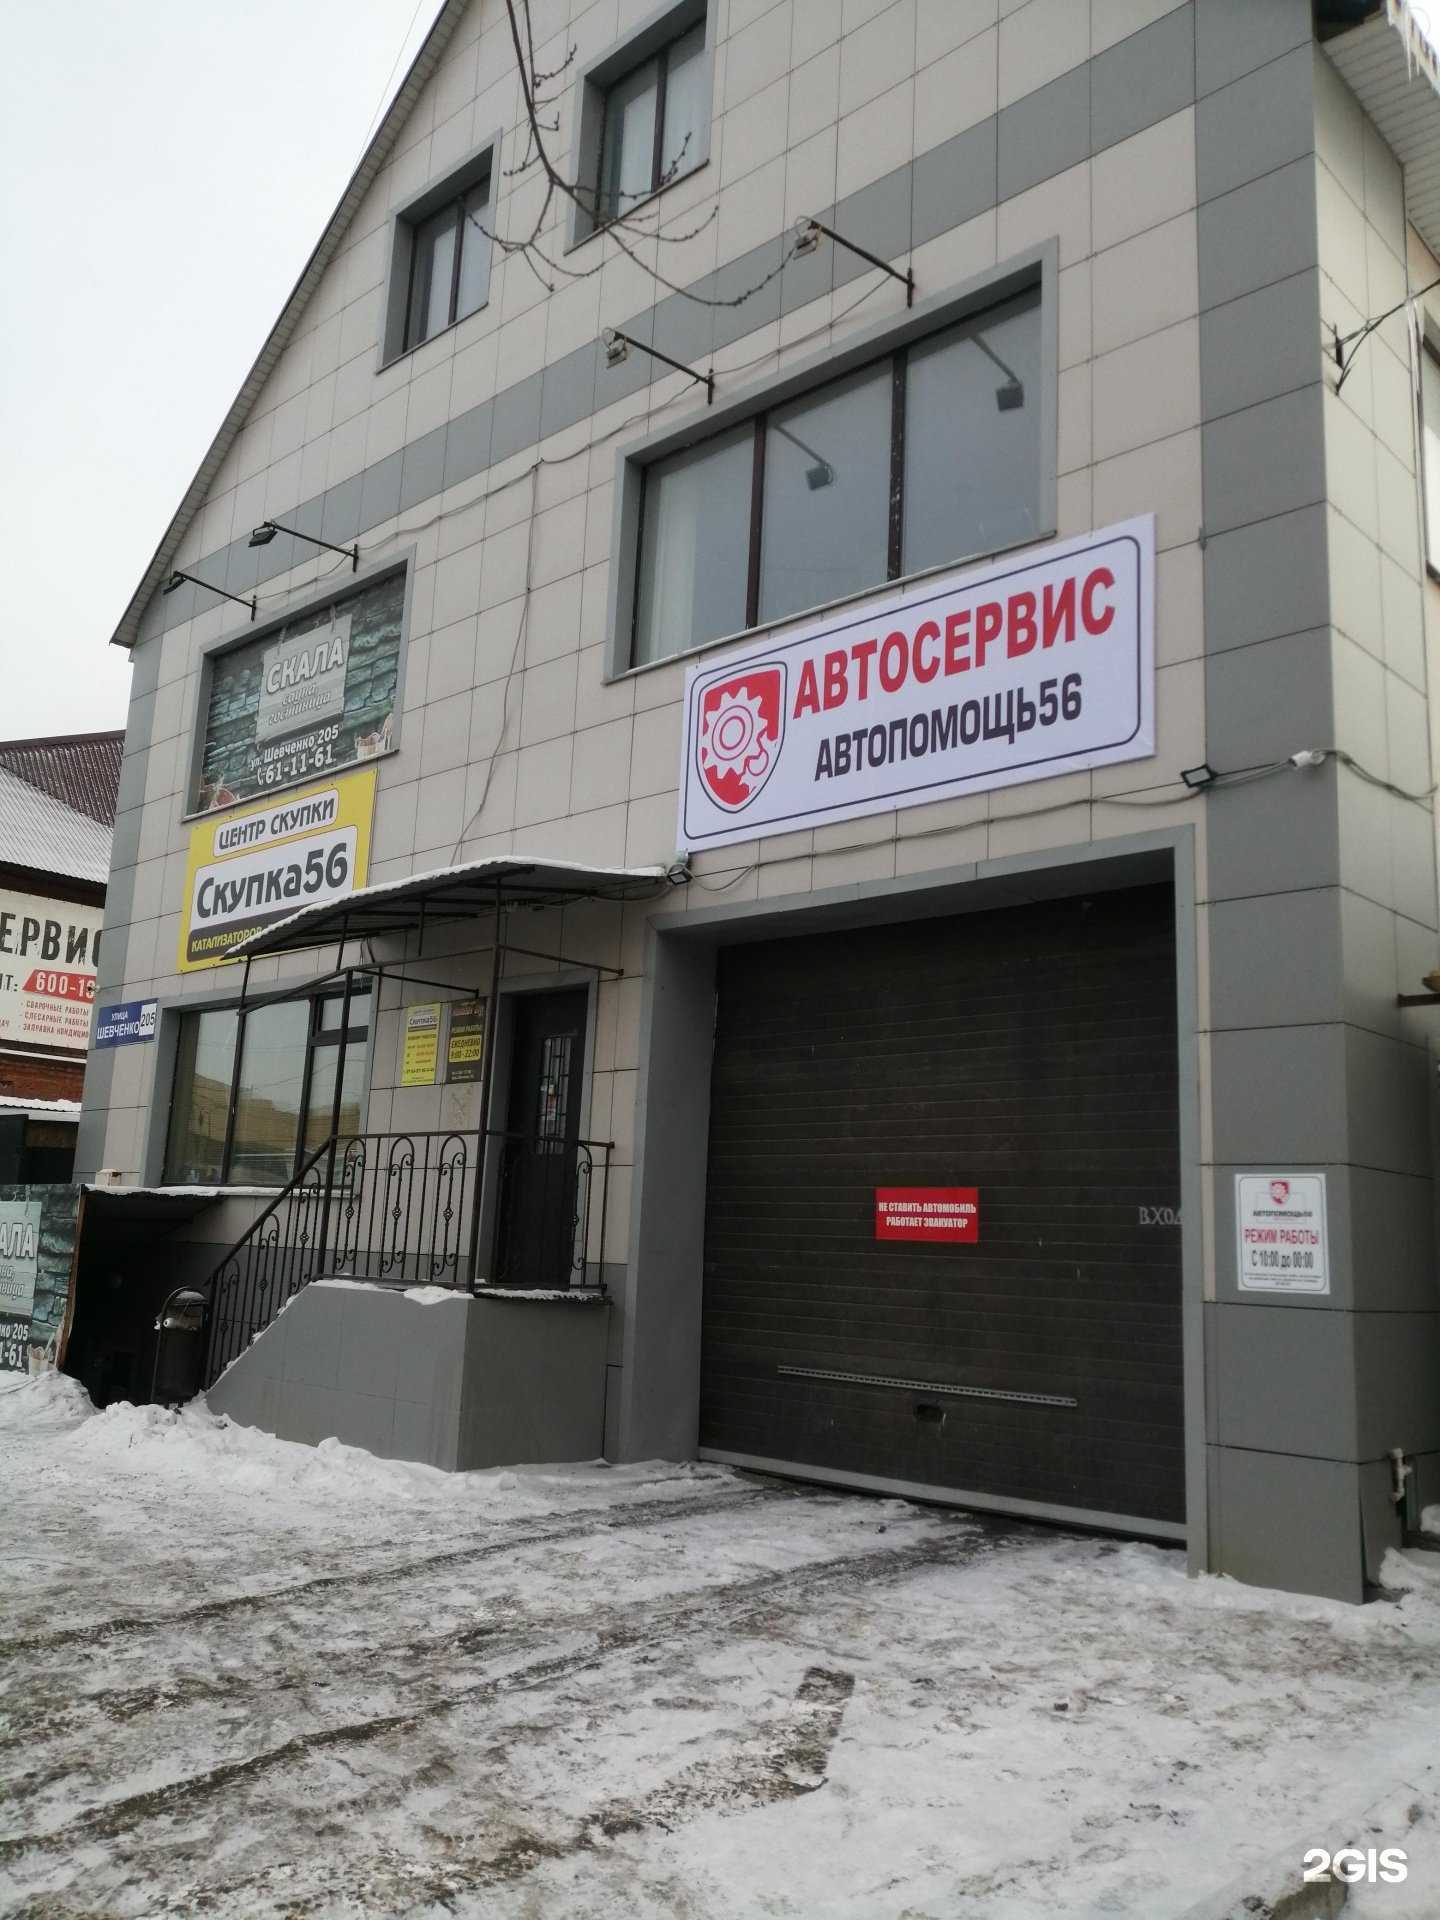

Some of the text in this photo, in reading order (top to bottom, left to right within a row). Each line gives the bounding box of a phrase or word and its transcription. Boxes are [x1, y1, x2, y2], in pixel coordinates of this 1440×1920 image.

[793, 567, 1116, 720] АВТОСЕРВИС
[266, 637, 344, 695] СКАЛА
[264, 735, 315, 764] Шевченко
[318, 724, 339, 744] 205
[814, 672, 1083, 781] АВТОПОМОЩЬ56
[265, 743, 333, 784] 61-11-61
[219, 798, 335, 850] ЦЕНТР СКУПКИ
[196, 842, 348, 919] Скупка56
[97, 1012, 155, 1039] ШЕВЧЕНКО 205
[112, 1011, 128, 1021] УЛИЦА
[879, 1202, 976, 1213] НЕ СТАВИТЬ АВТОМОБИЛЬ
[886, 1217, 922, 1227] РАБОТАЕТ
[1245, 1229, 1319, 1245] РЕЖИМ РАБОТЫ
[12, 1323, 29, 1341] 205
